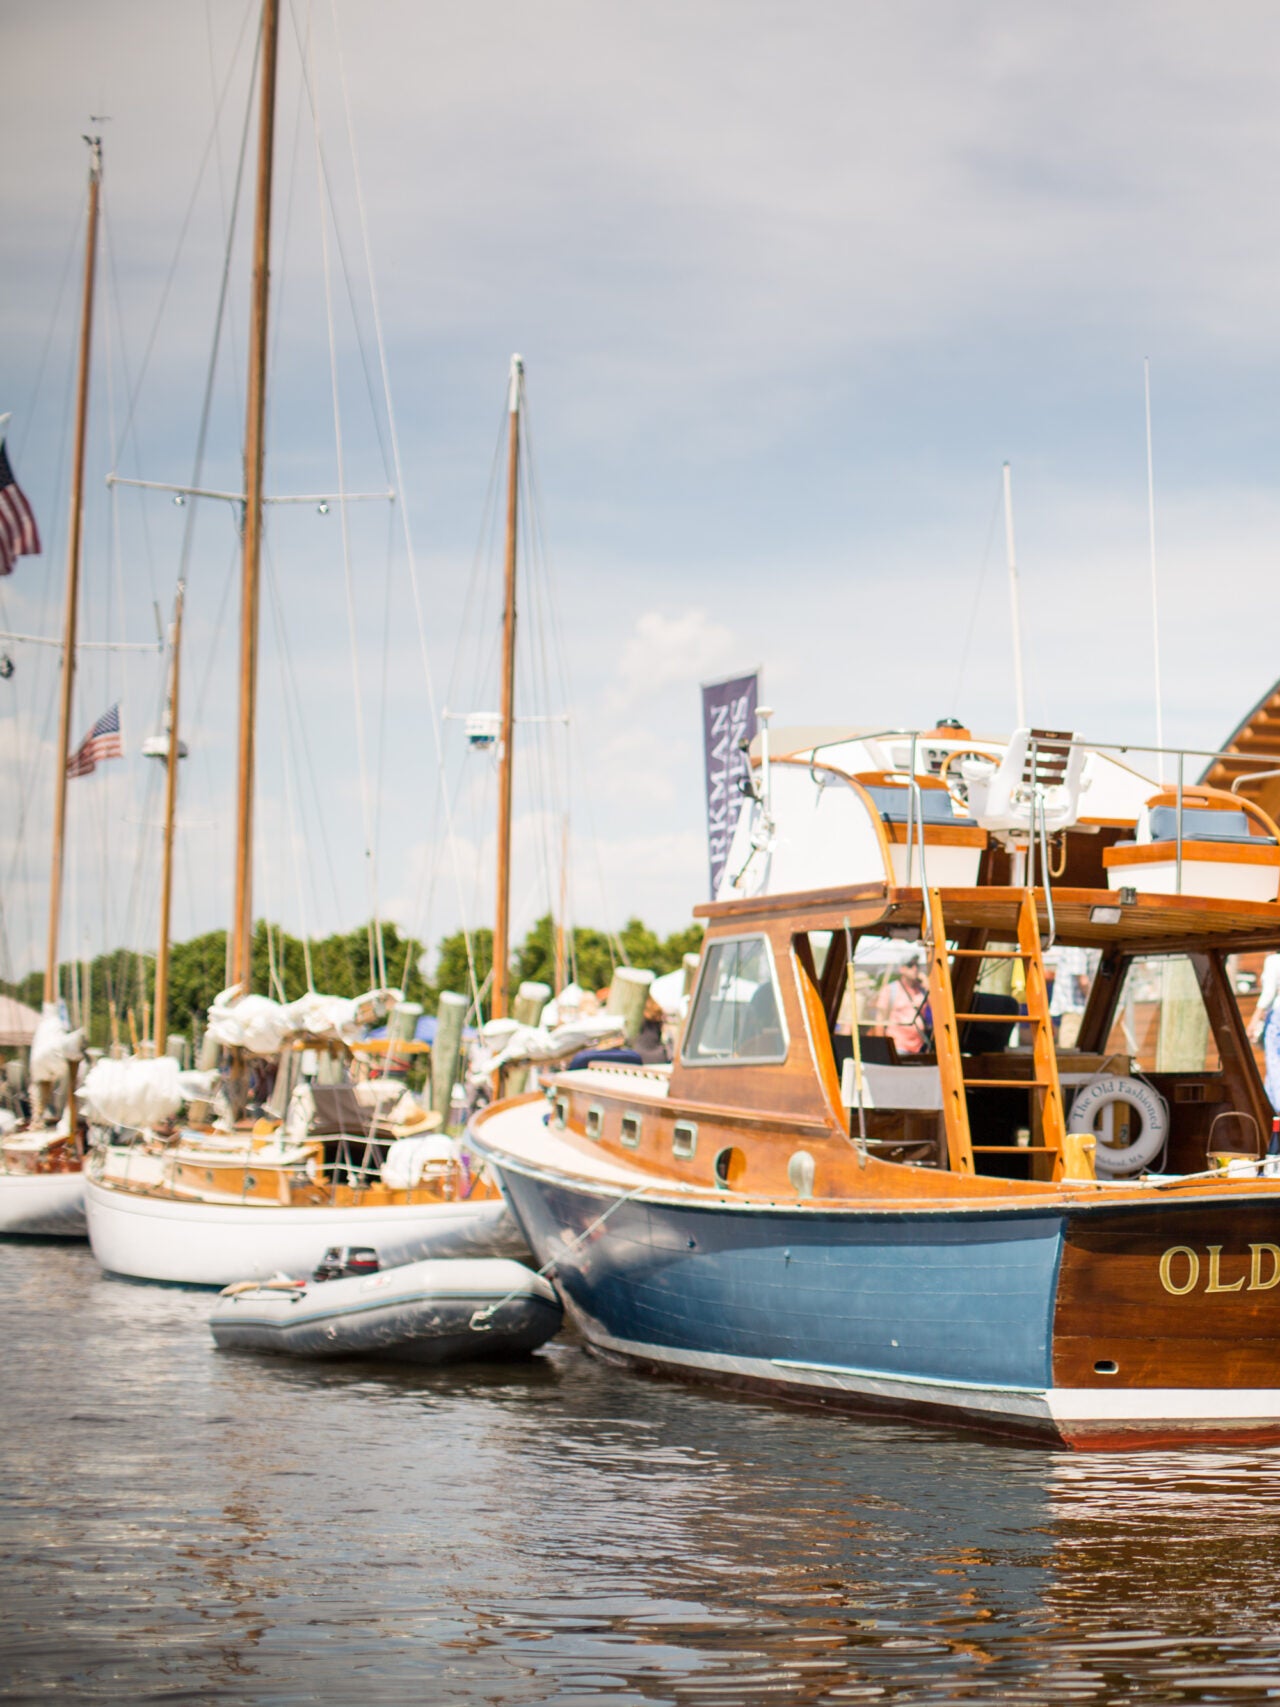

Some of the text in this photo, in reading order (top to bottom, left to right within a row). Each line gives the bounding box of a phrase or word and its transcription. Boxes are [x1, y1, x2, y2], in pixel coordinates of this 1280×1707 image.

[1073, 1081, 1161, 1130] The Old Fashioned
